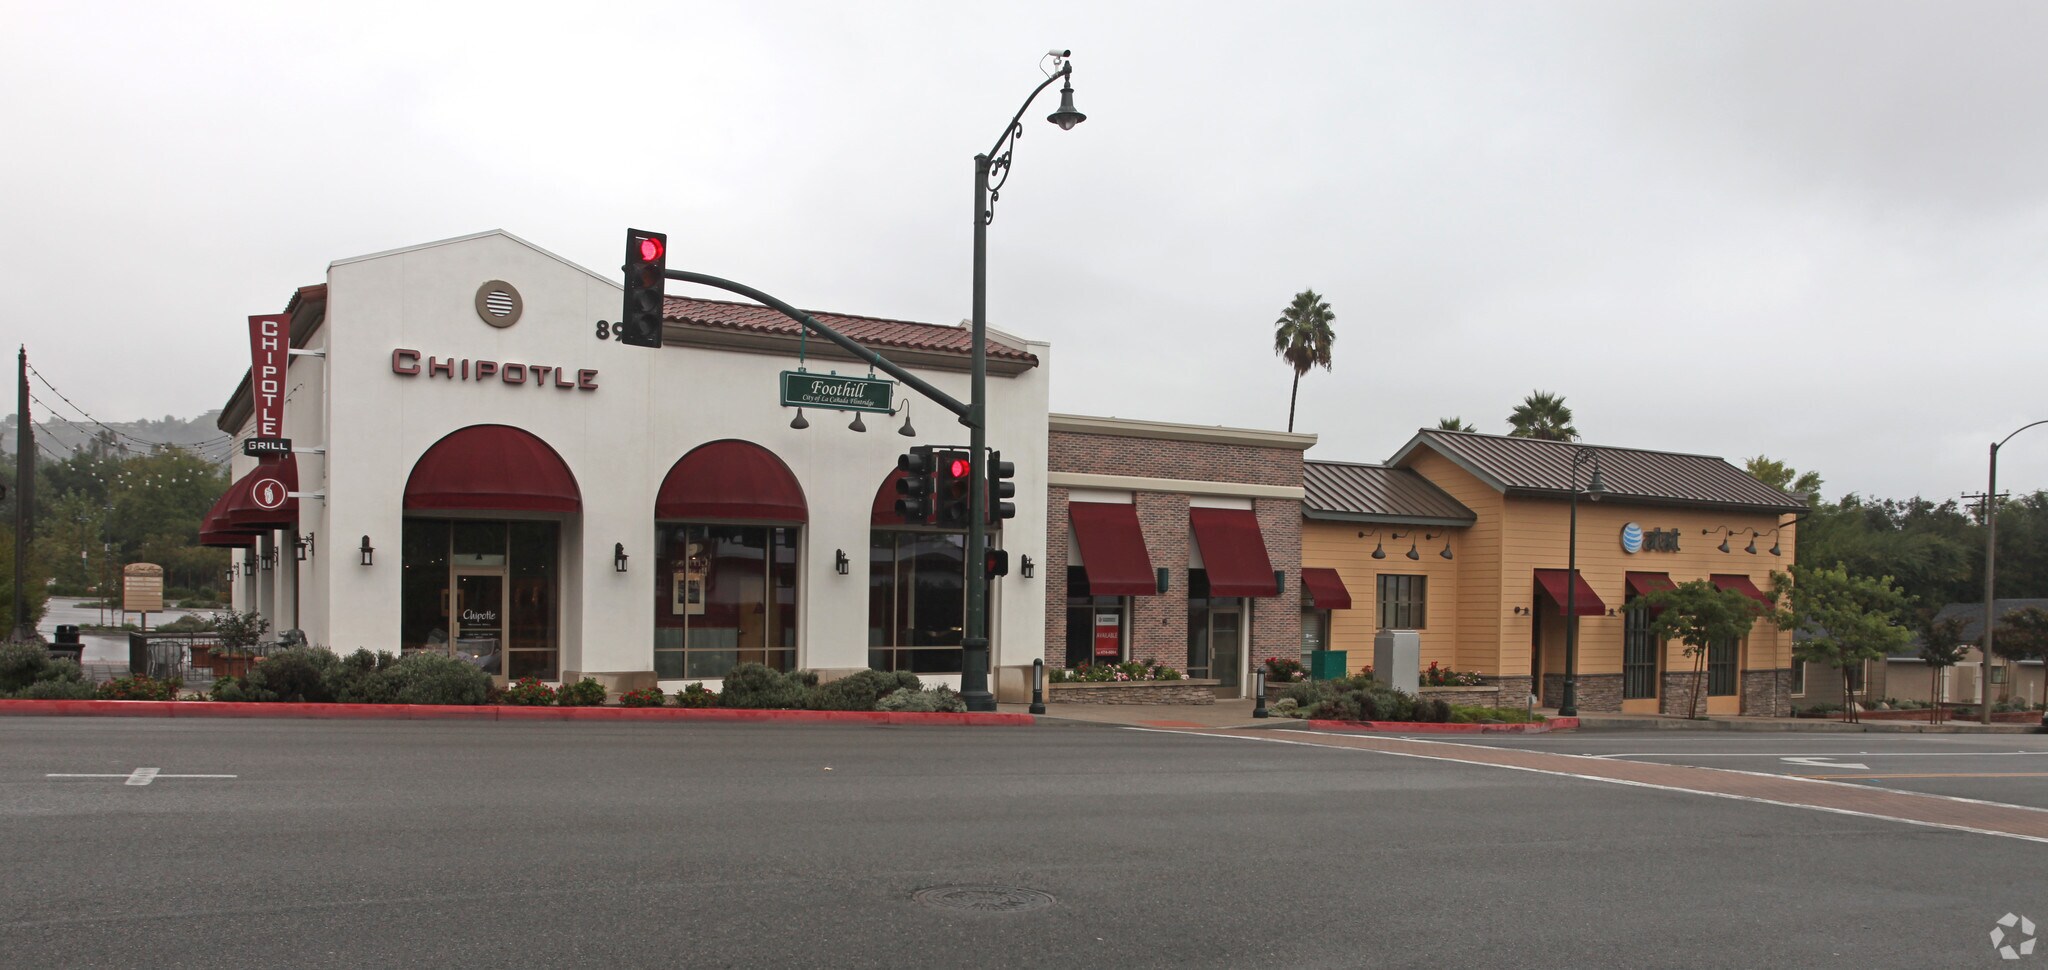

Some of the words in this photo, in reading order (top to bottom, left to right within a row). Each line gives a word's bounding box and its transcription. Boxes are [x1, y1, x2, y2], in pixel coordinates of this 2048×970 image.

[392, 348, 598, 390] CHIPOTLE
[261, 320, 278, 435] CHIPOTLE
[811, 380, 868, 398] Foothill
[802, 394, 814, 402] City
[248, 441, 288, 450] GRILL
[463, 608, 496, 622] Chipotle
